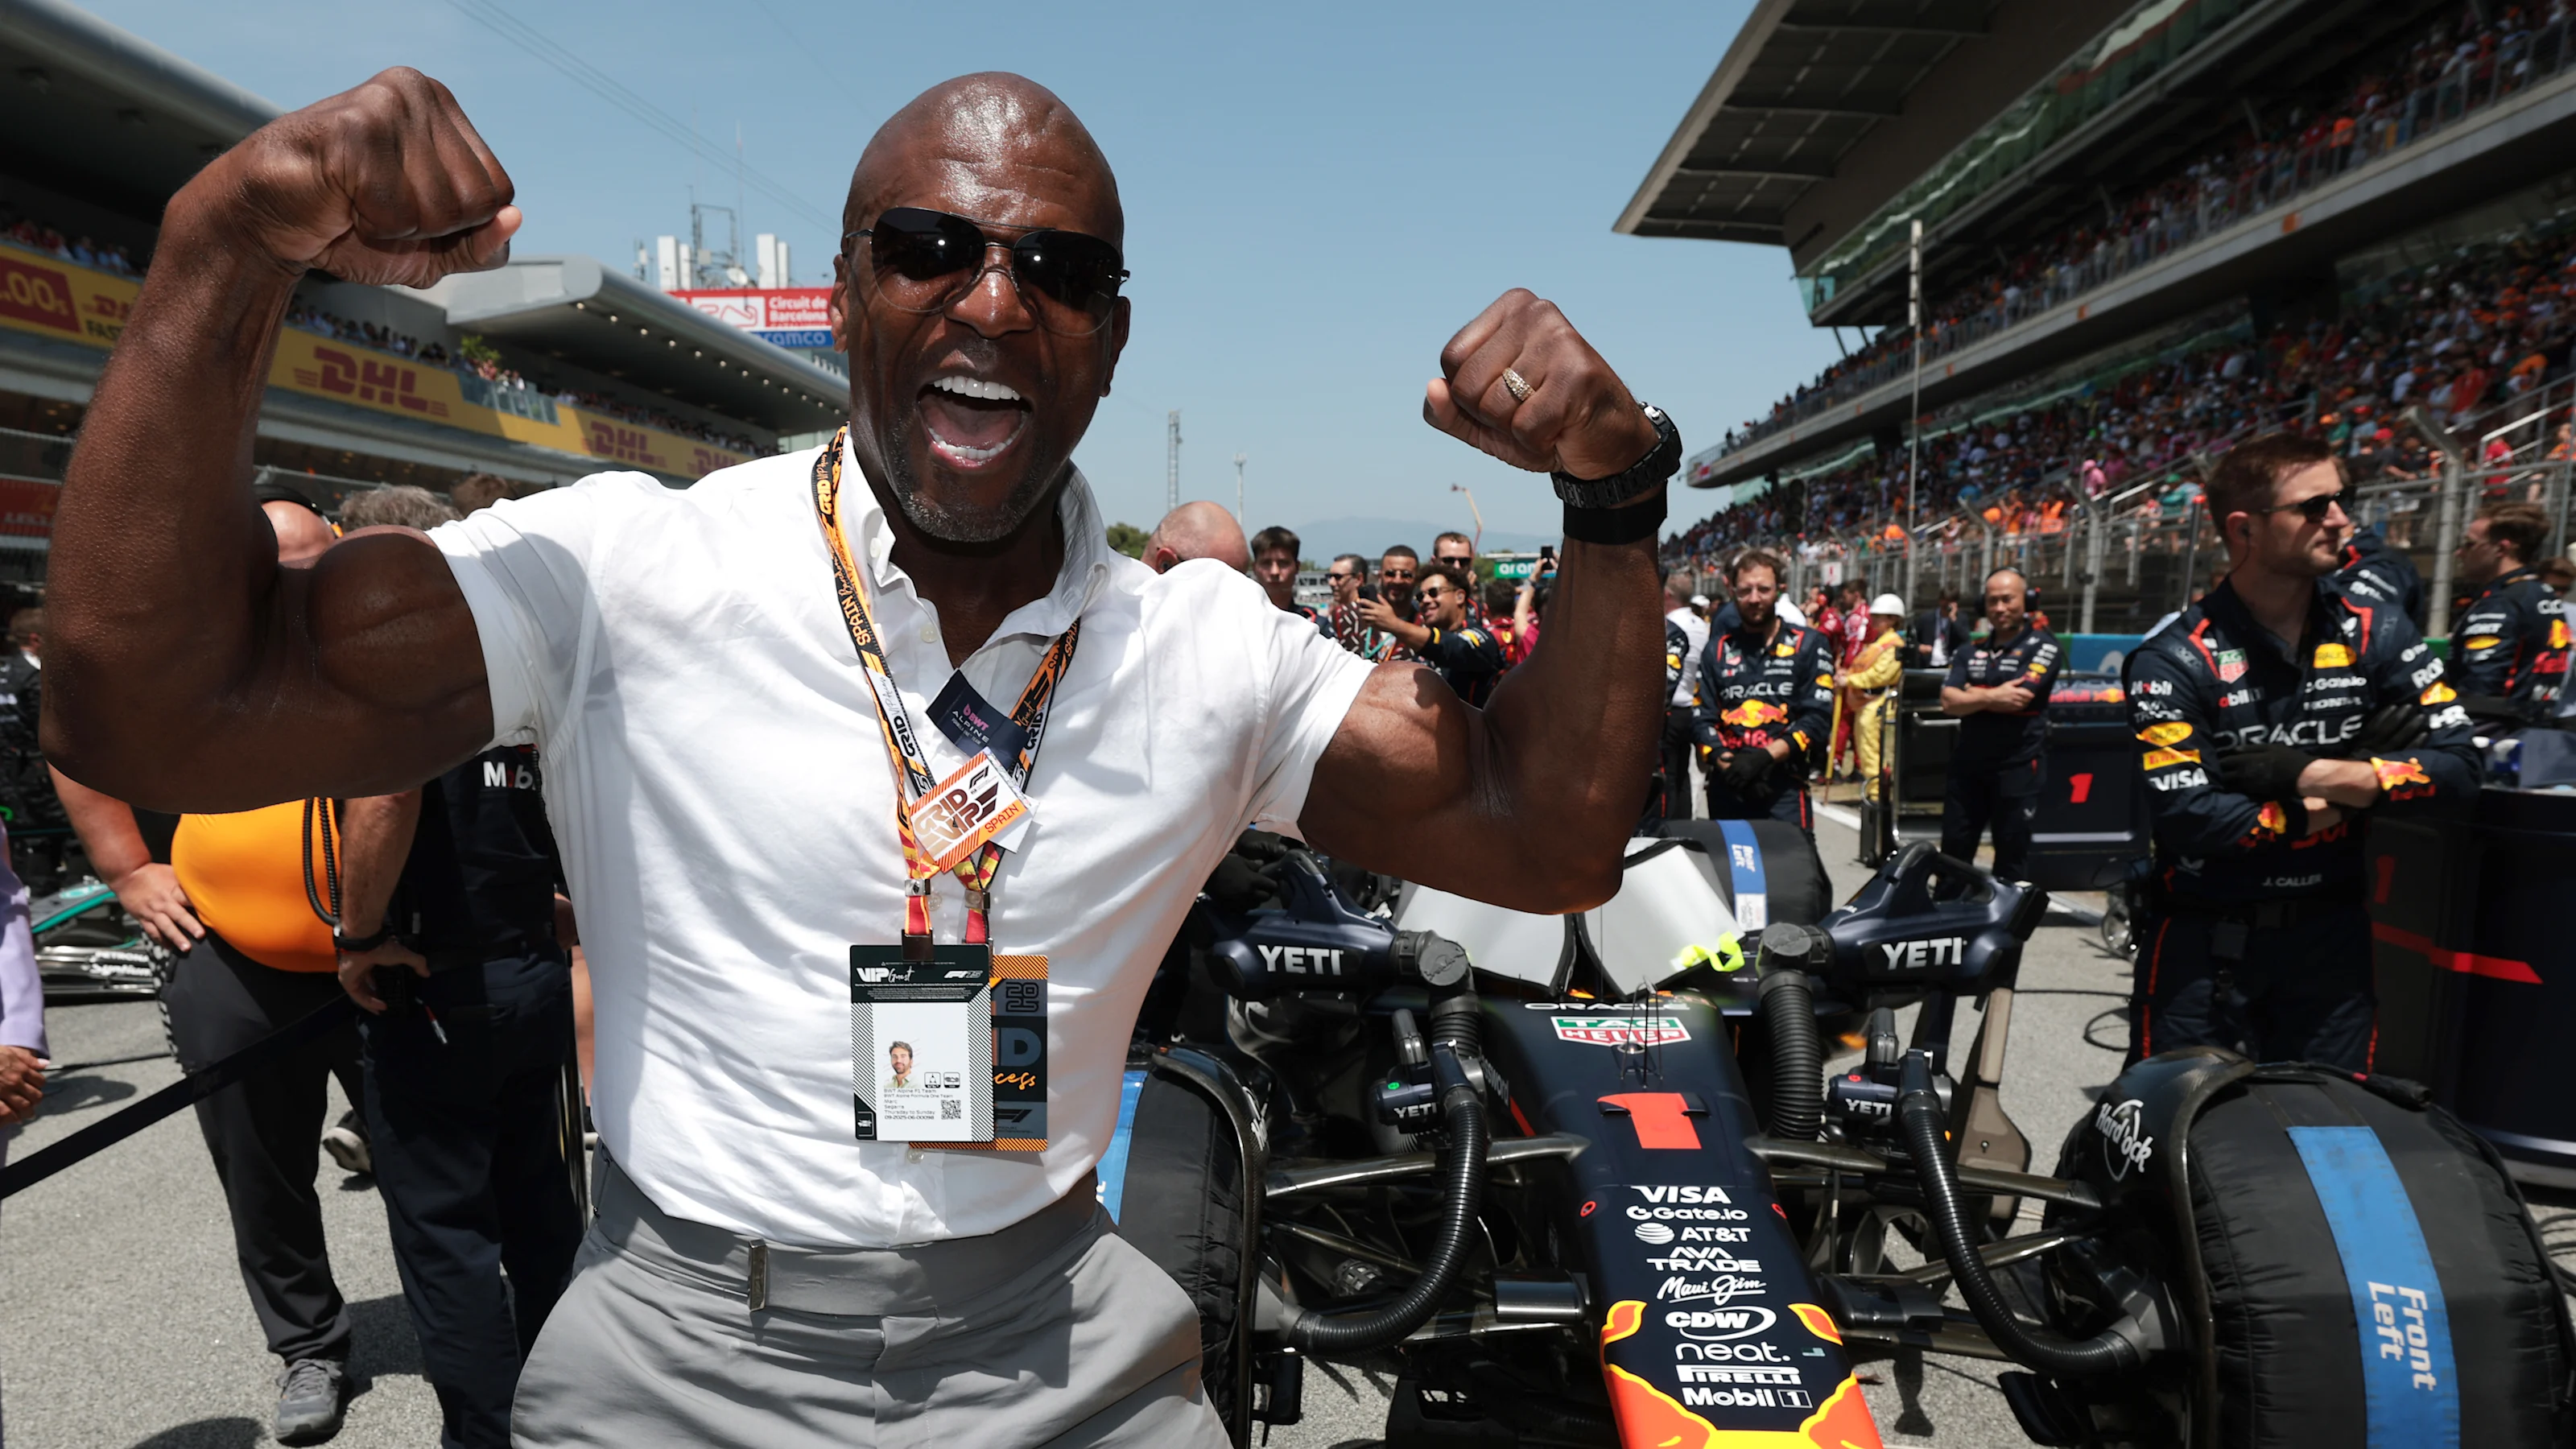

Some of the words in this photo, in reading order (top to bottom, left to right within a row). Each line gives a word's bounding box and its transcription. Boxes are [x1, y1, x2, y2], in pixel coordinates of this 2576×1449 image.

[770, 297, 810, 308] Circuit
[813, 297, 828, 308] de
[770, 310, 828, 321] Barcelona
[314, 345, 427, 412] DHL
[590, 421, 654, 465] DHL
[817, 479, 832, 515] GRID
[841, 595, 872, 646] SPAIN
[1719, 683, 1794, 699] ORACLE
[2130, 680, 2173, 696] Mobil
[2219, 690, 2250, 708] obil
[952, 711, 989, 743] ALPINE
[968, 712, 989, 731] BWT
[1025, 712, 1043, 749] GRID
[894, 716, 915, 757] GRID
[2213, 715, 2364, 752] ORACLE
[2068, 773, 2093, 803] 1
[2149, 768, 2209, 791] VISA
[914, 789, 968, 836] GRID
[935, 803, 980, 840] VIP
[985, 803, 1019, 833] SPAIN
[1257, 945, 1342, 976] YETI
[1881, 937, 1963, 971] YETI
[856, 968, 890, 982] VIP
[888, 966, 914, 983] Guest
[1525, 1002, 1690, 1010] ORACLE
[1563, 1018, 1672, 1028] TAG
[1563, 1030, 1682, 1042] HEUER
[993, 1071, 1036, 1091] cess
[1393, 1102, 1437, 1119] YETI
[1845, 1098, 1893, 1116] YETI
[1597, 1092, 1703, 1150] 1
[2095, 1102, 2130, 1145] Hard
[1631, 1186, 1732, 1203] VISA
[1655, 1207, 1748, 1220] Gate.io
[1680, 1227, 1752, 1243] AT&T
[1669, 1246, 1733, 1259] AVA
[1646, 1258, 1762, 1273] TRADE
[1656, 1276, 1711, 1300] Maui
[1711, 1274, 1767, 1306] Jim
[1665, 1311, 1751, 1329] CDW
[2368, 1281, 2405, 1361] Left
[2397, 1286, 2437, 1391] Front
[1675, 1341, 1791, 1362] neat.
[1675, 1364, 1802, 1385] PIRELLI
[1682, 1387, 1776, 1407] Mobil
